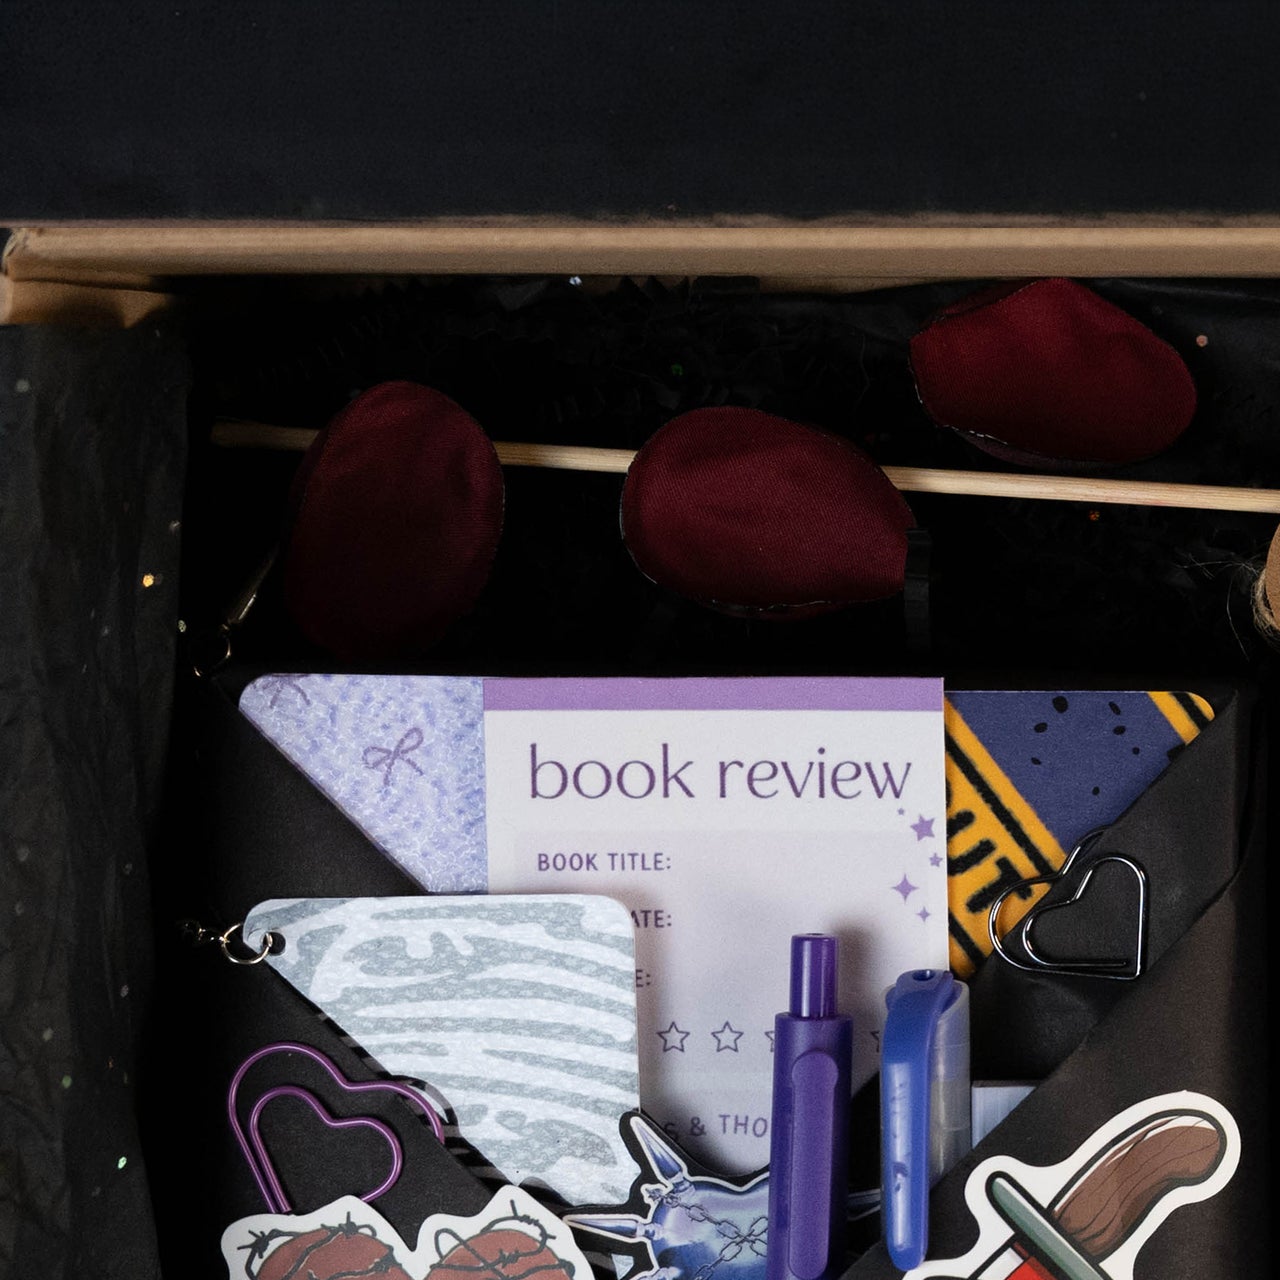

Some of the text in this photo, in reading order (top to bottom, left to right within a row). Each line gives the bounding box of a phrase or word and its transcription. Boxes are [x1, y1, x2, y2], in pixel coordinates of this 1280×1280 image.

[529, 743, 912, 799] book review
[537, 853, 672, 871] BOOK TITLE:
[631, 910, 672, 928] ATE:
